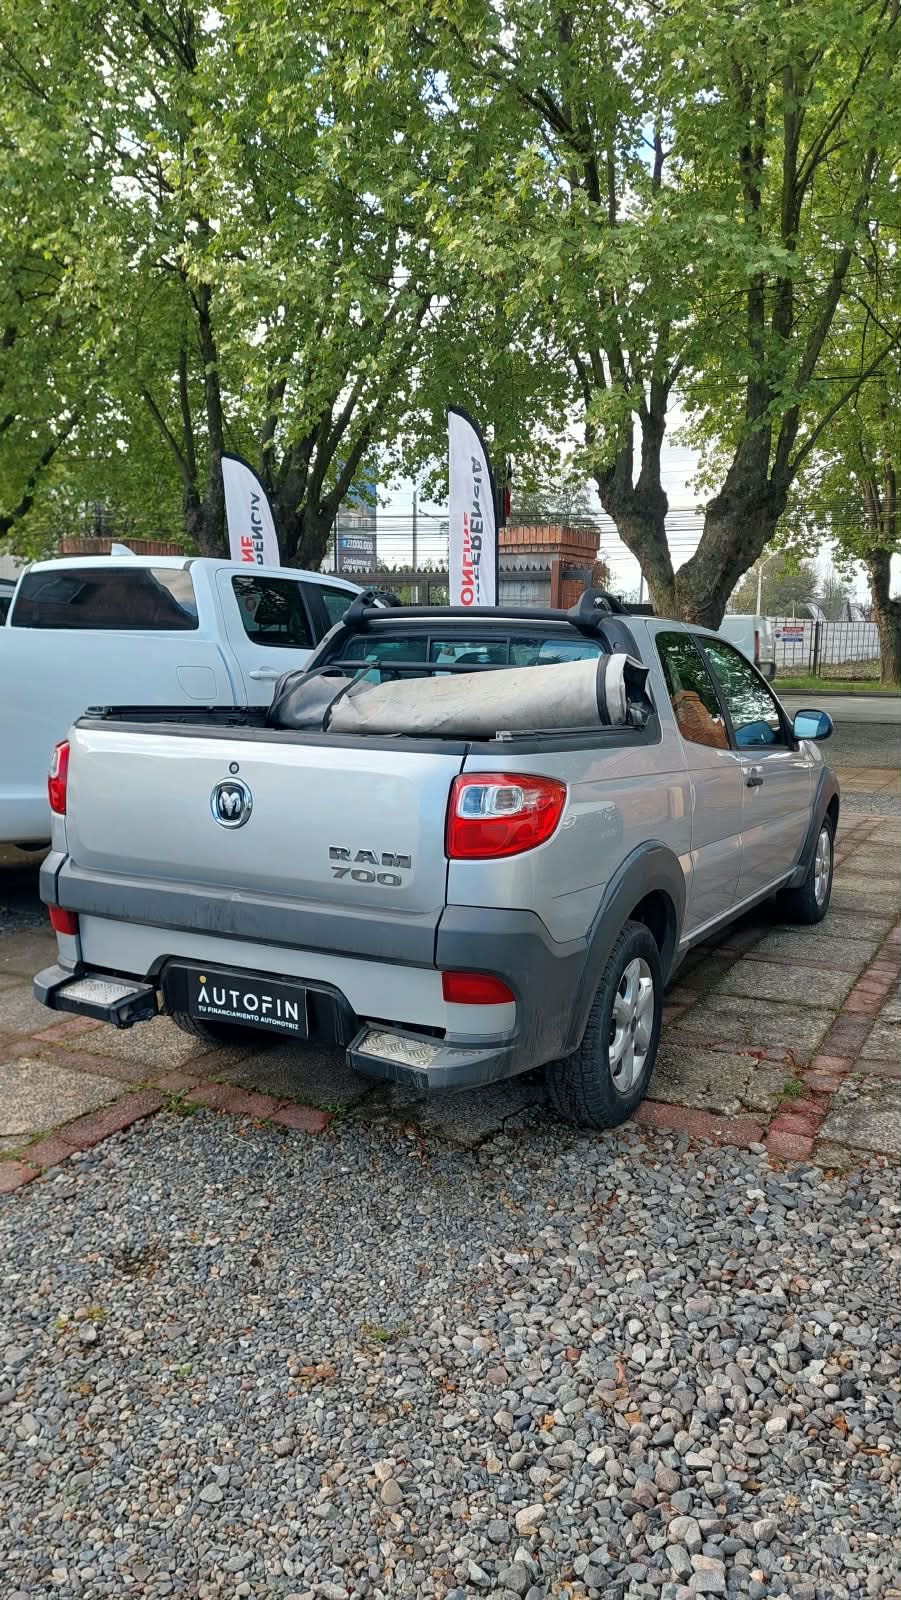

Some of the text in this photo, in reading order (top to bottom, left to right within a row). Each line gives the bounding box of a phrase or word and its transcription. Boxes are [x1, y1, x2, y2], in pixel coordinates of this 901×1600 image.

[329, 845, 411, 869] RAM
[331, 866, 402, 887] 700
[198, 985, 299, 1021] AUTOFIN
[207, 1006, 259, 1021] FINANCIAMIENTO
[260, 1016, 299, 1030] AUTOMOTRIZ
